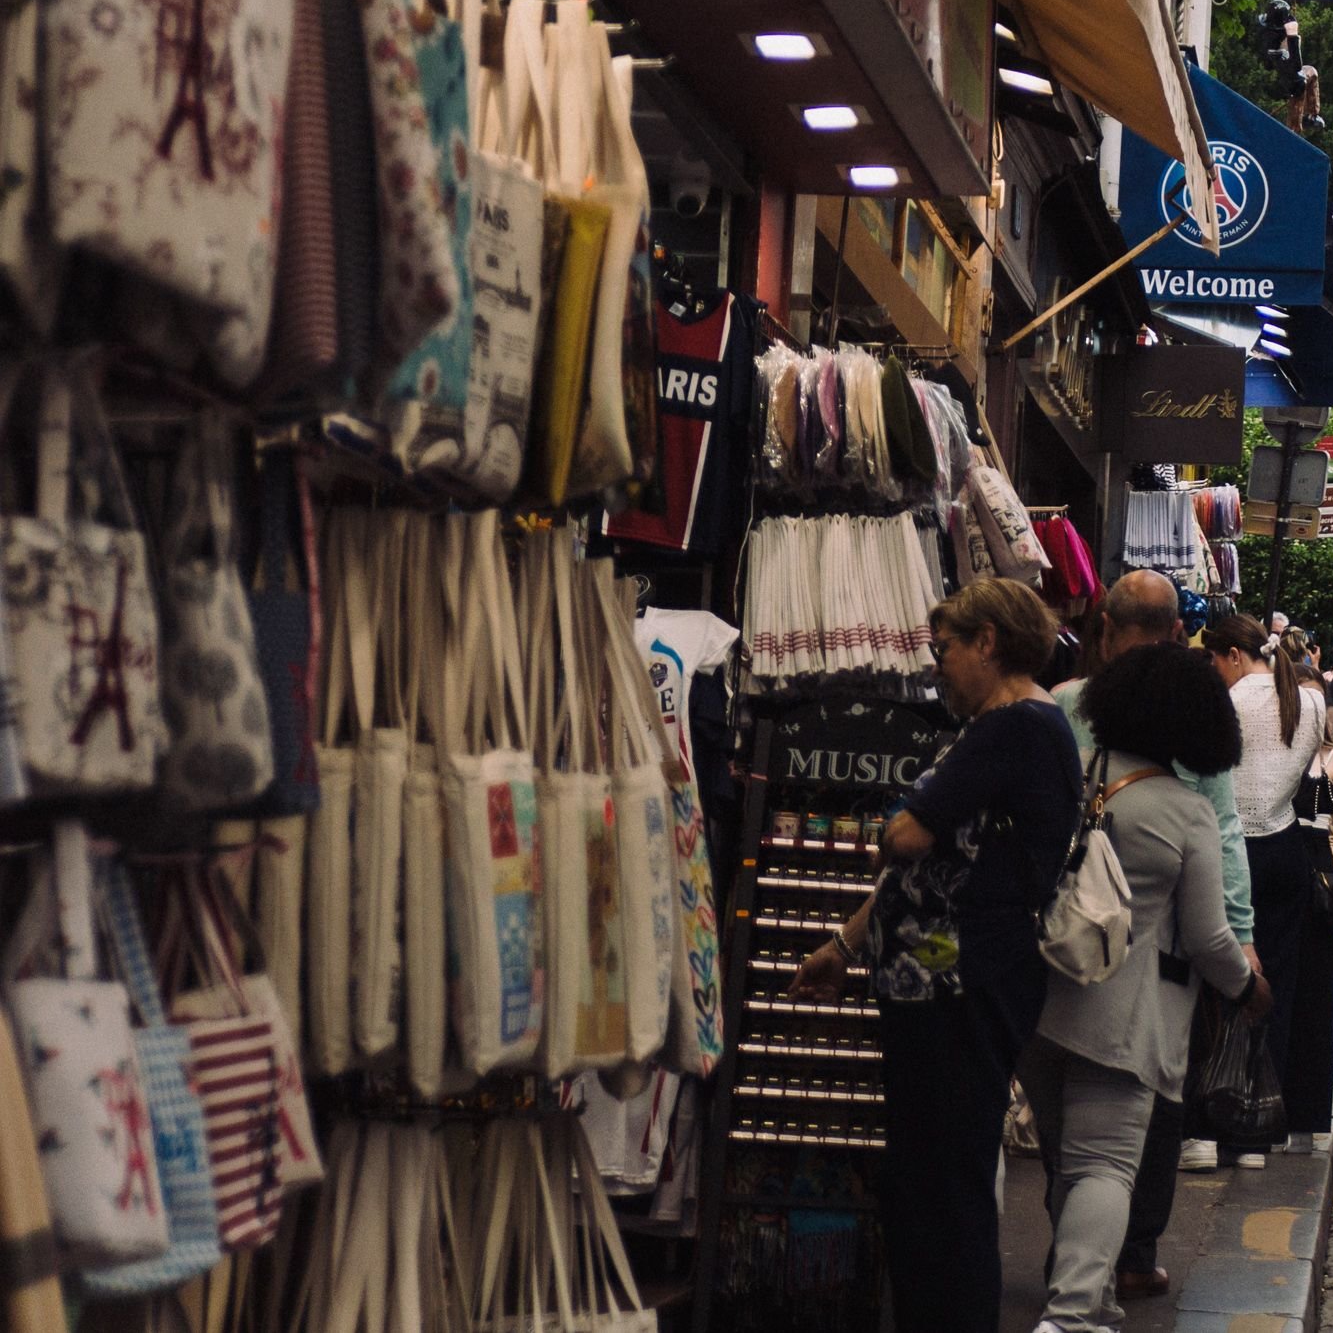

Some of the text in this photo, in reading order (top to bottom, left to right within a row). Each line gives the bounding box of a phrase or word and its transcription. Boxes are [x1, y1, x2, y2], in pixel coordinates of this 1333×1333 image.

[1212, 146, 1250, 173] RIS
[1140, 268, 1275, 299] Welcome
[658, 367, 718, 406] RIS
[1131, 390, 1218, 419] Lindt
[786, 747, 920, 786] MUSIC
